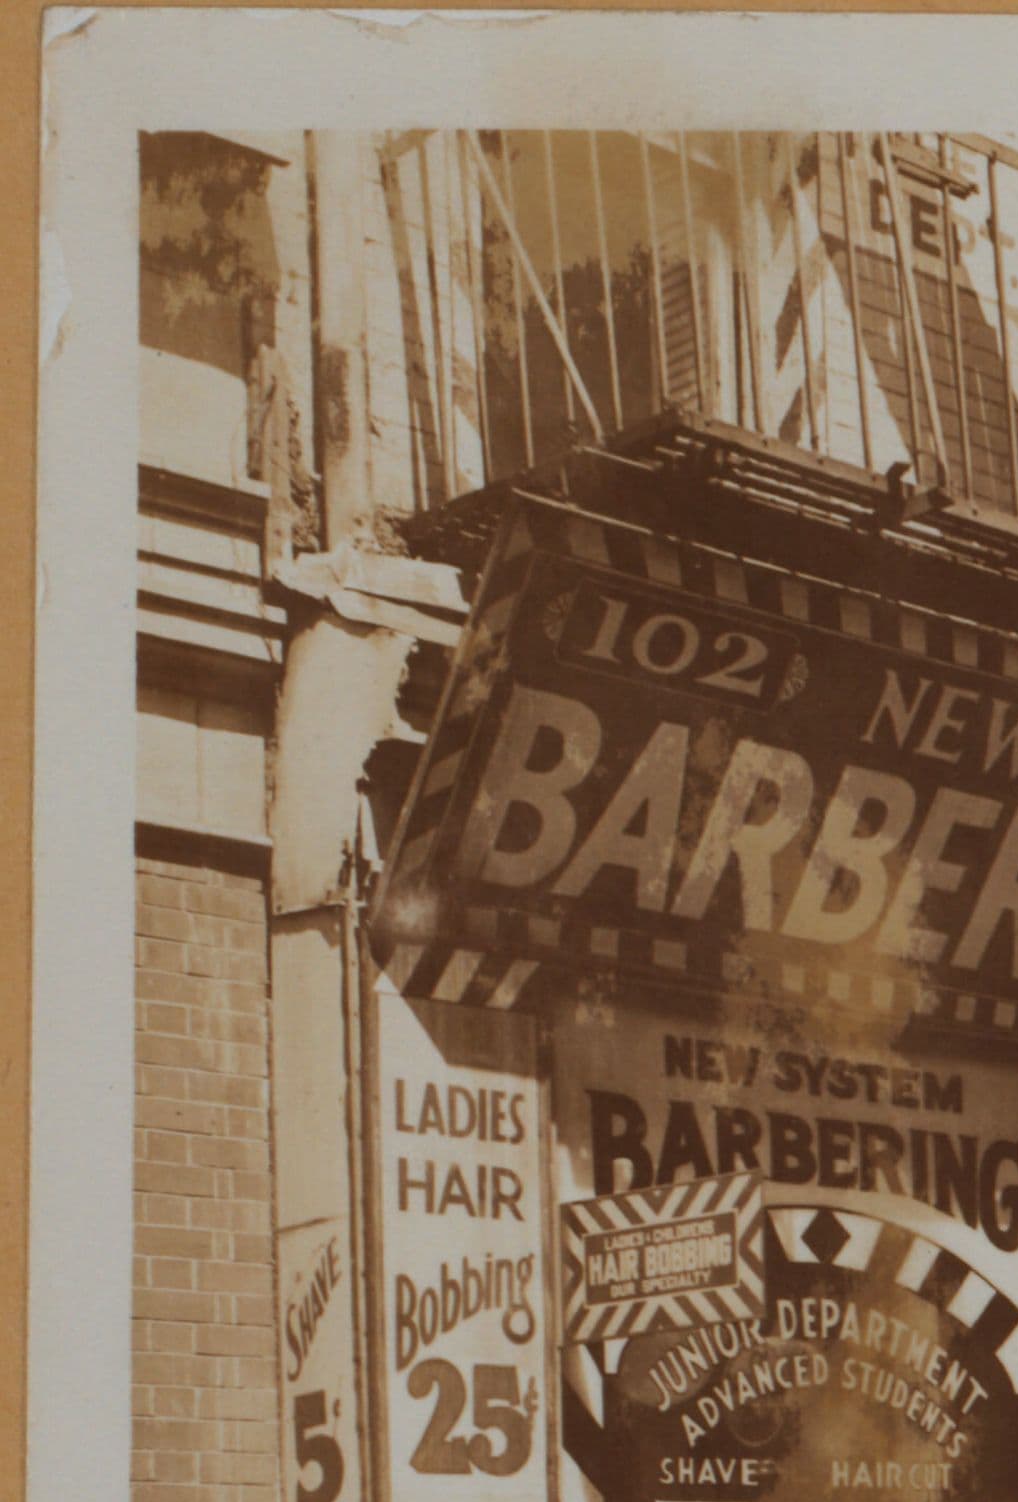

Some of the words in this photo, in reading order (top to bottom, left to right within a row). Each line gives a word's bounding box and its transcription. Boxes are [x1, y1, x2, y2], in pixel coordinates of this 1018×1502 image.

[582, 597, 770, 697] 102
[394, 1078, 527, 1146] LADIES
[664, 1035, 760, 1088] NEW
[774, 1057, 964, 1114] SYSTEM
[398, 1157, 526, 1222] HAIR
[588, 1249, 640, 1286] HAIR
[645, 1233, 732, 1278] BOBBING
[610, 1282, 636, 1298] OUR
[641, 1270, 712, 1294] SPECIALTY
[284, 1236, 343, 1382] SHAVE
[394, 1252, 537, 1372] Bobbing
[650, 1319, 766, 1412] JUNIOR
[777, 1297, 988, 1414] DEPARTMENT
[407, 1357, 539, 1477] 25¢
[681, 1353, 829, 1447] ADVANCED
[841, 1359, 969, 1459] STUDENTS
[659, 1457, 761, 1487] SHAVE
[831, 1460, 904, 1489] HAIR
[909, 1462, 955, 1491] CUT
